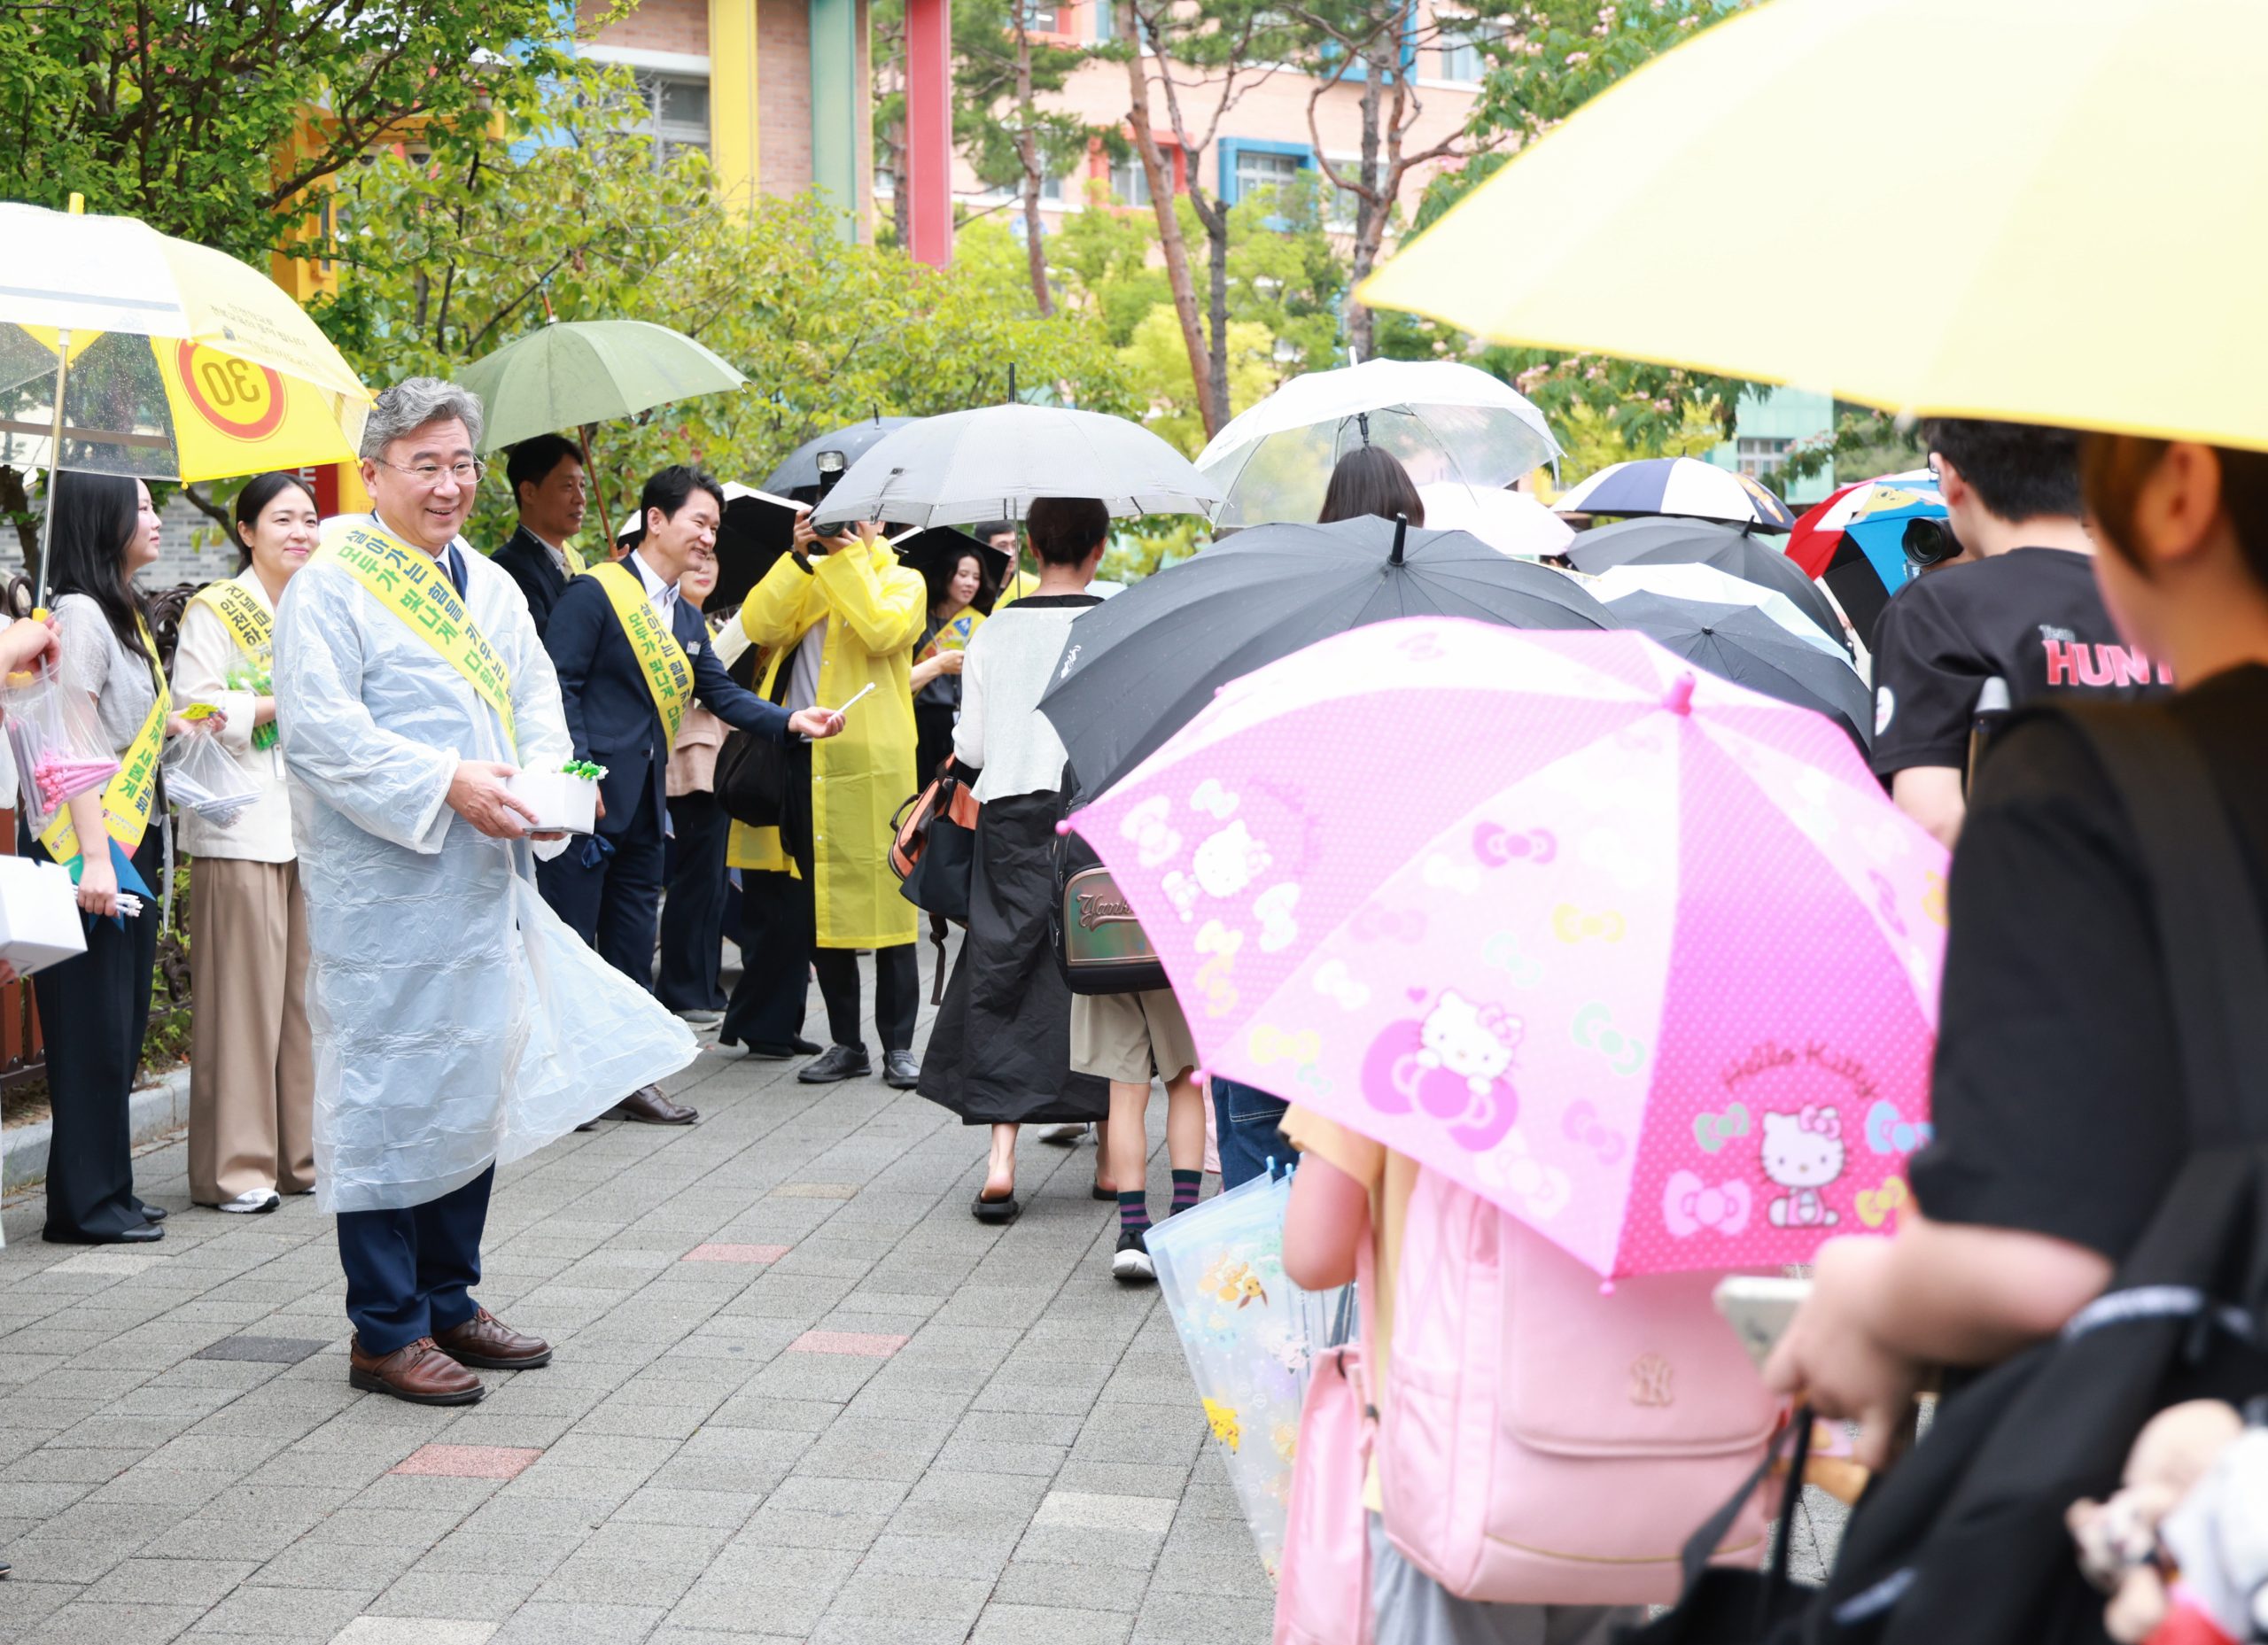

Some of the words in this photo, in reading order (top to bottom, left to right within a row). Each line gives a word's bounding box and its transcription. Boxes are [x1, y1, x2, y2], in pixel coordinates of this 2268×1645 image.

[337, 545, 402, 594] 모두가
[345, 529, 429, 585] 살아가는
[427, 580, 463, 624] 힘을
[465, 623, 505, 682] 키우는
[628, 612, 656, 656] 모두가
[640, 603, 676, 657] 살아가는
[668, 661, 688, 688] 힘을
[119, 748, 154, 801] 새롭게
[1076, 894, 1135, 927] Yank
